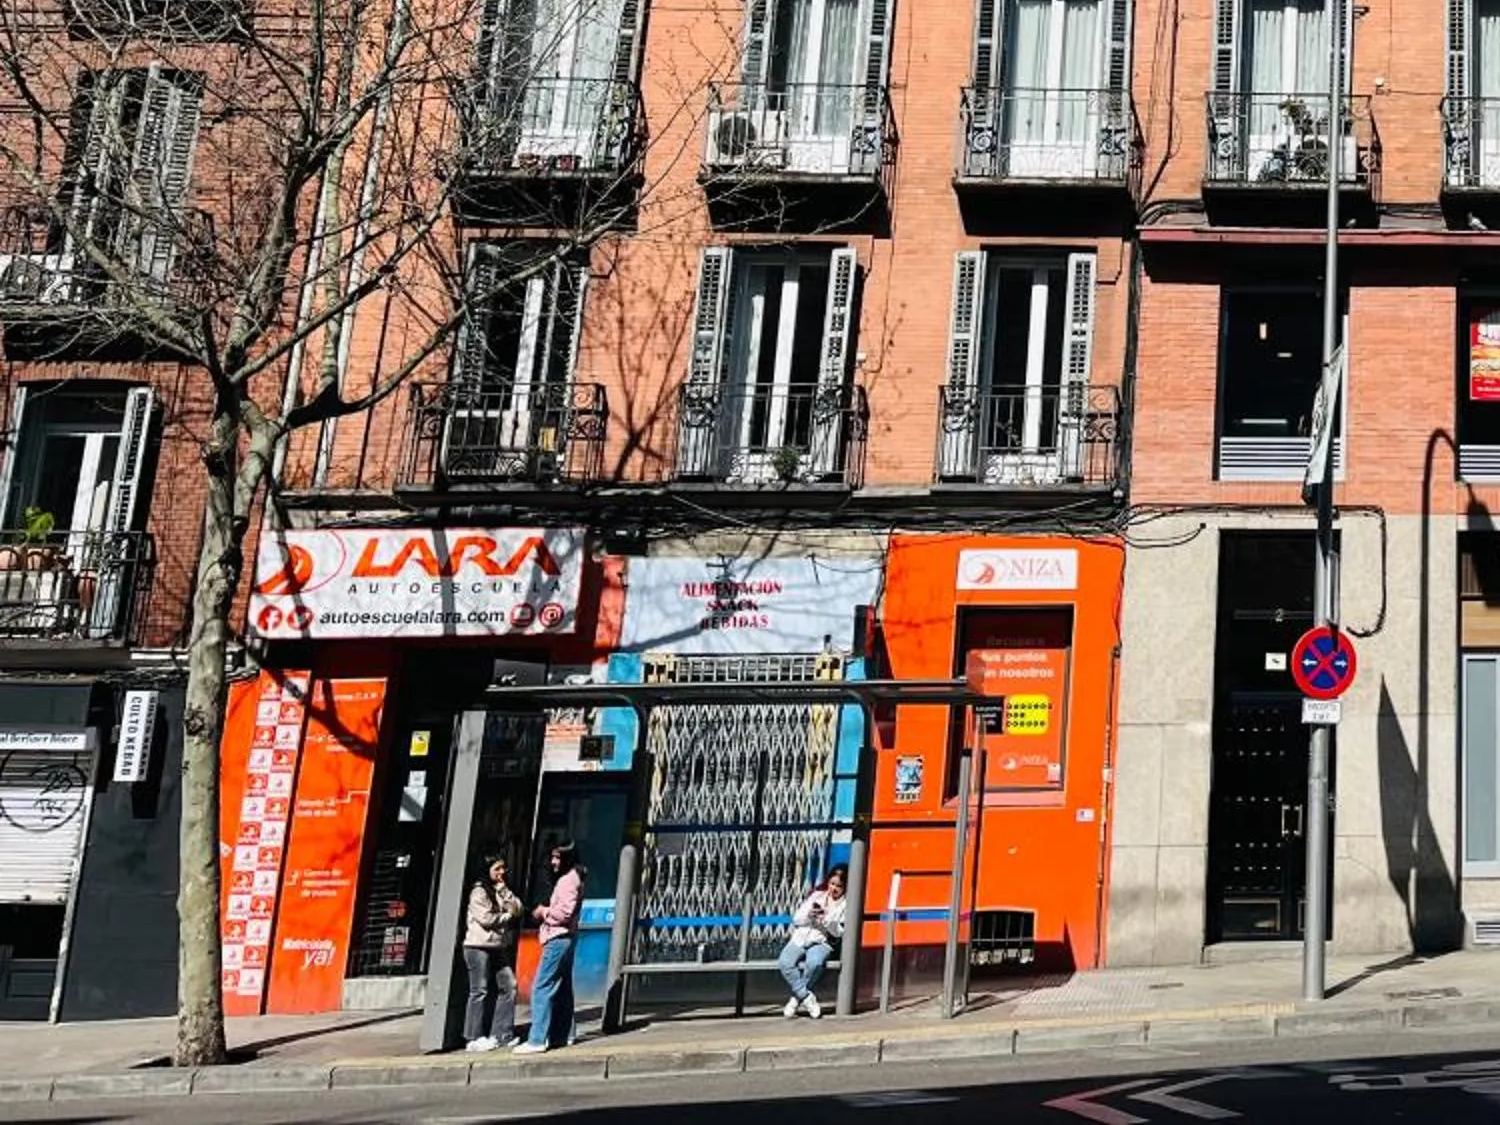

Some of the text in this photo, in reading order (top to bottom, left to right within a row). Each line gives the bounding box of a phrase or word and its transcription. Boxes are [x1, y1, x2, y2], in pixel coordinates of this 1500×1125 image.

[351, 536, 561, 577] LARA
[1010, 558, 1064, 576] NIZA
[348, 582, 562, 595] AUTOESCUELA
[705, 600, 759, 612] SNACK
[319, 609, 505, 625] autoescuelalara.com
[700, 615, 769, 629] BEBIDAS
[1276, 608, 1285, 622] 2
[999, 666, 1055, 679] nosotros
[303, 948, 335, 970] ya!
